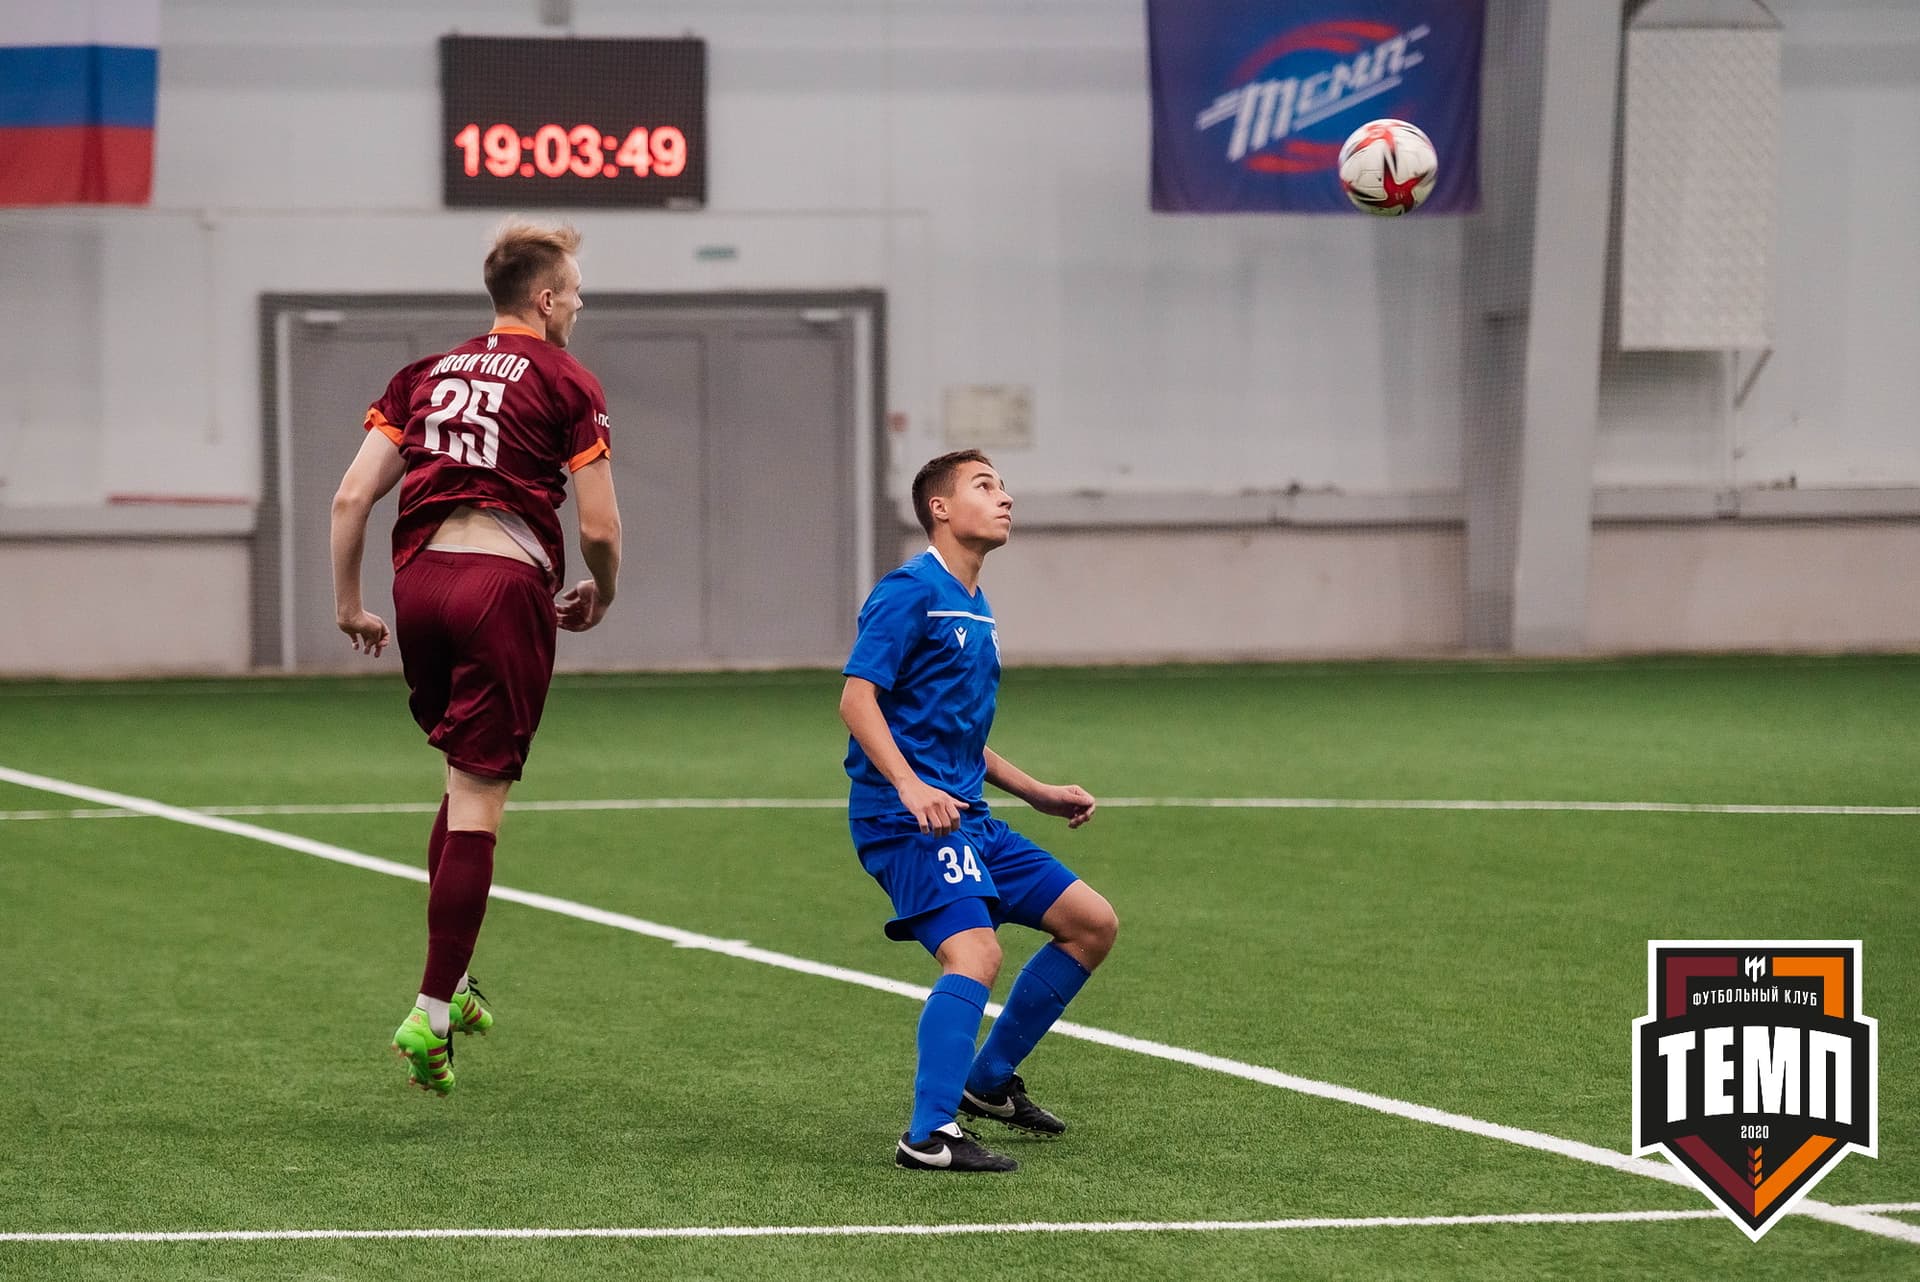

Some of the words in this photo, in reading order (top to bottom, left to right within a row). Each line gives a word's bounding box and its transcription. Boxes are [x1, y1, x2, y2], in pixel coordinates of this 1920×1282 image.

[454, 123, 687, 178] 19:03:49
[430, 351, 530, 383] НОВИЧКОВ
[424, 377, 506, 469] 25
[937, 845, 982, 884] 34
